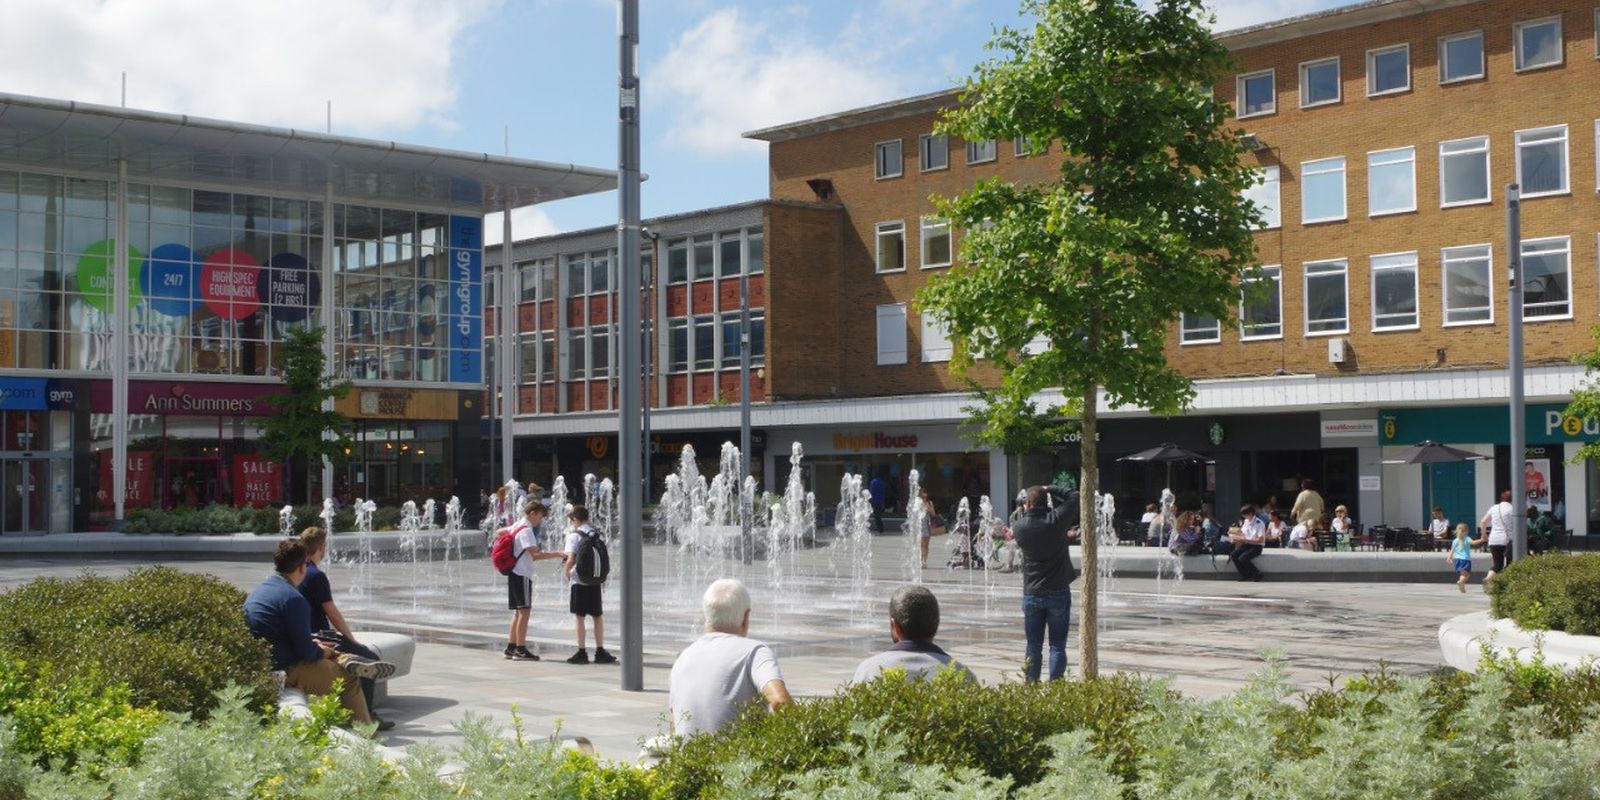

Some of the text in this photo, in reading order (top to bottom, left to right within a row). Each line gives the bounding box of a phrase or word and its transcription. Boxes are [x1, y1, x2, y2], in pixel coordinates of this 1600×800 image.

[163, 273, 184, 287] 24/7
[212, 270, 254, 285] HIGH SPEC
[280, 270, 299, 282] FREE
[209, 283, 257, 298] EQUMENT
[273, 281, 306, 294] PARKING
[49, 390, 73, 402] gym
[145, 393, 253, 411] Ann Summers
[832, 431, 918, 451] BrightHouse
[1063, 432, 1100, 442] COFE
[110, 458, 143, 471] SLE
[242, 461, 273, 473] SALE
[246, 482, 270, 491] HALF
[245, 491, 271, 501] PRICE
